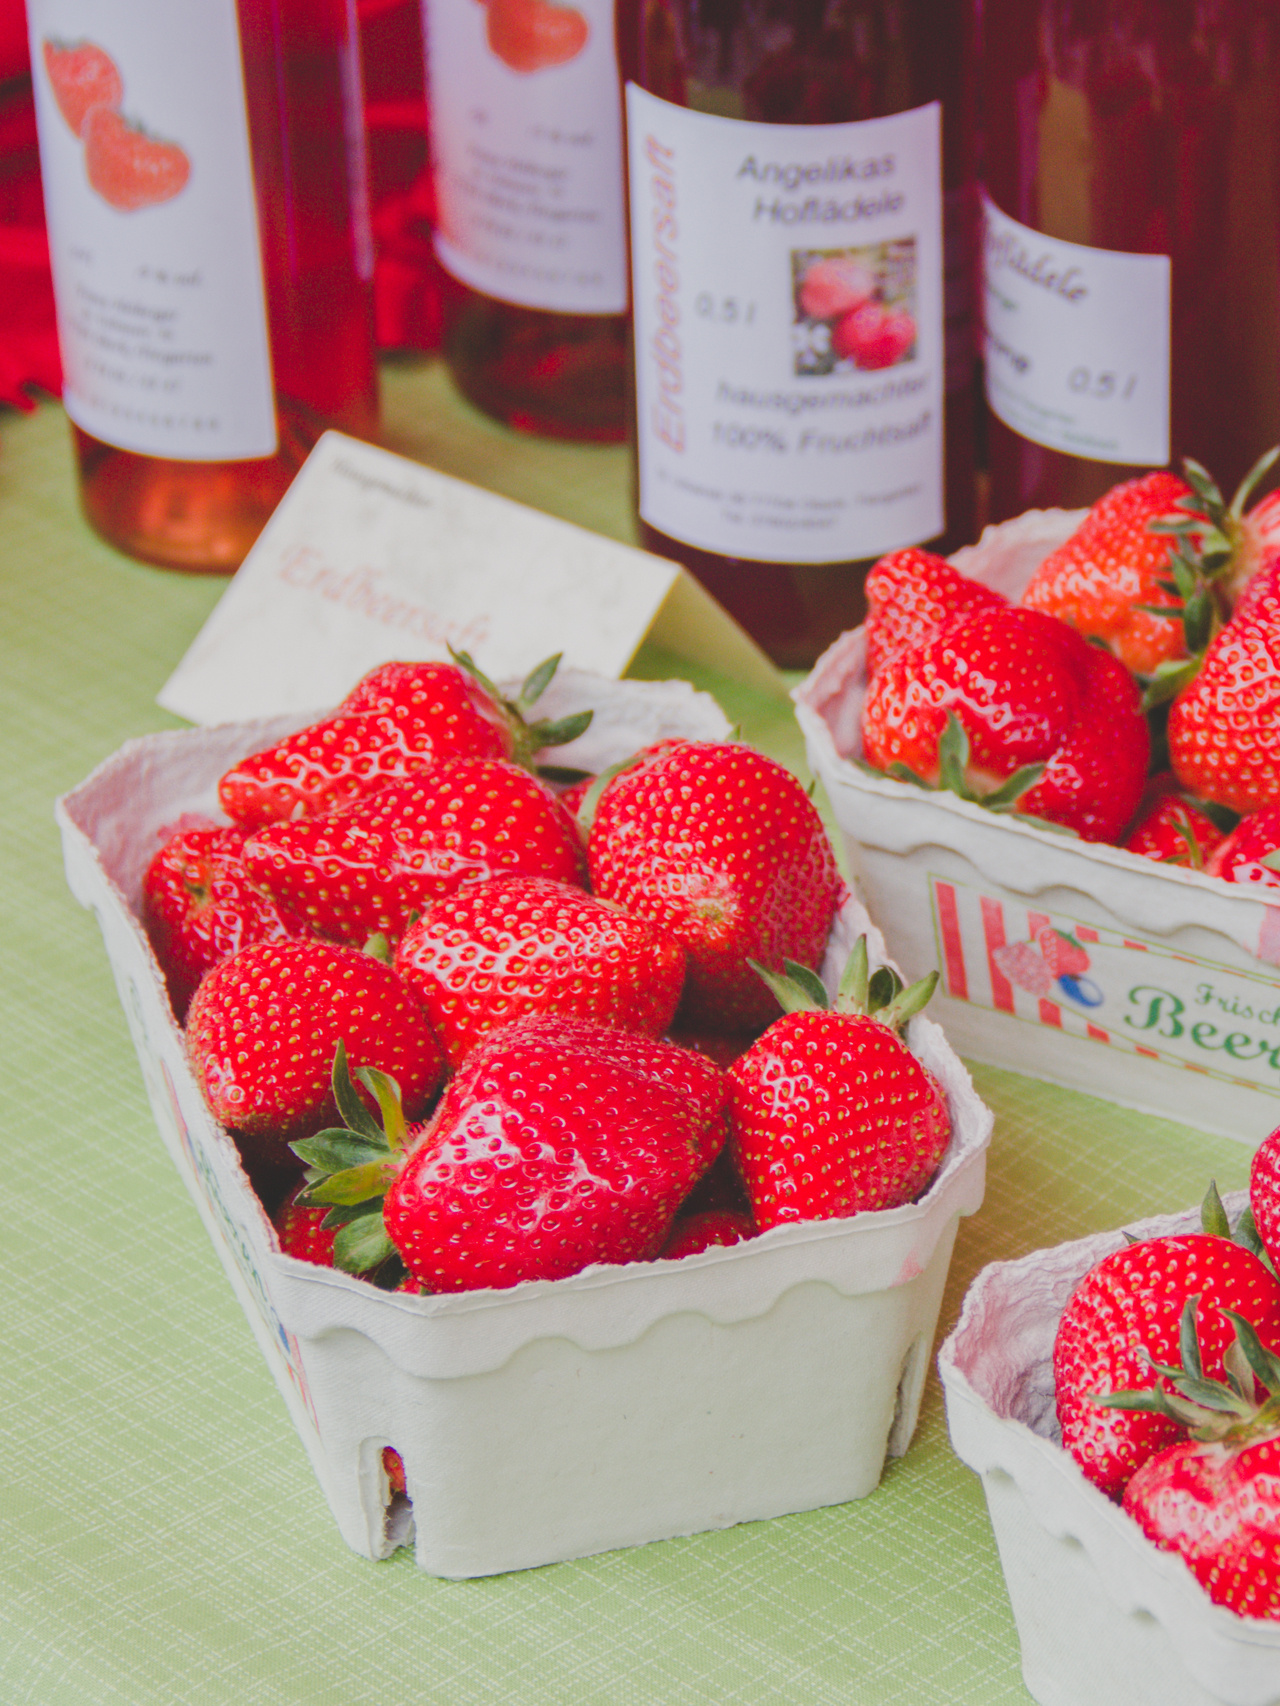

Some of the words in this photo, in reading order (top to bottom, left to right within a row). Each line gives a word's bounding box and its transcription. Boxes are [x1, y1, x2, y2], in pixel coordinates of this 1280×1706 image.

[736, 153, 896, 191] Angelikas
[753, 192, 905, 225] Hoflädele
[646, 133, 686, 453] Erdbeersaft
[712, 420, 787, 453] 100%
[799, 411, 932, 453] Fruchtsaft
